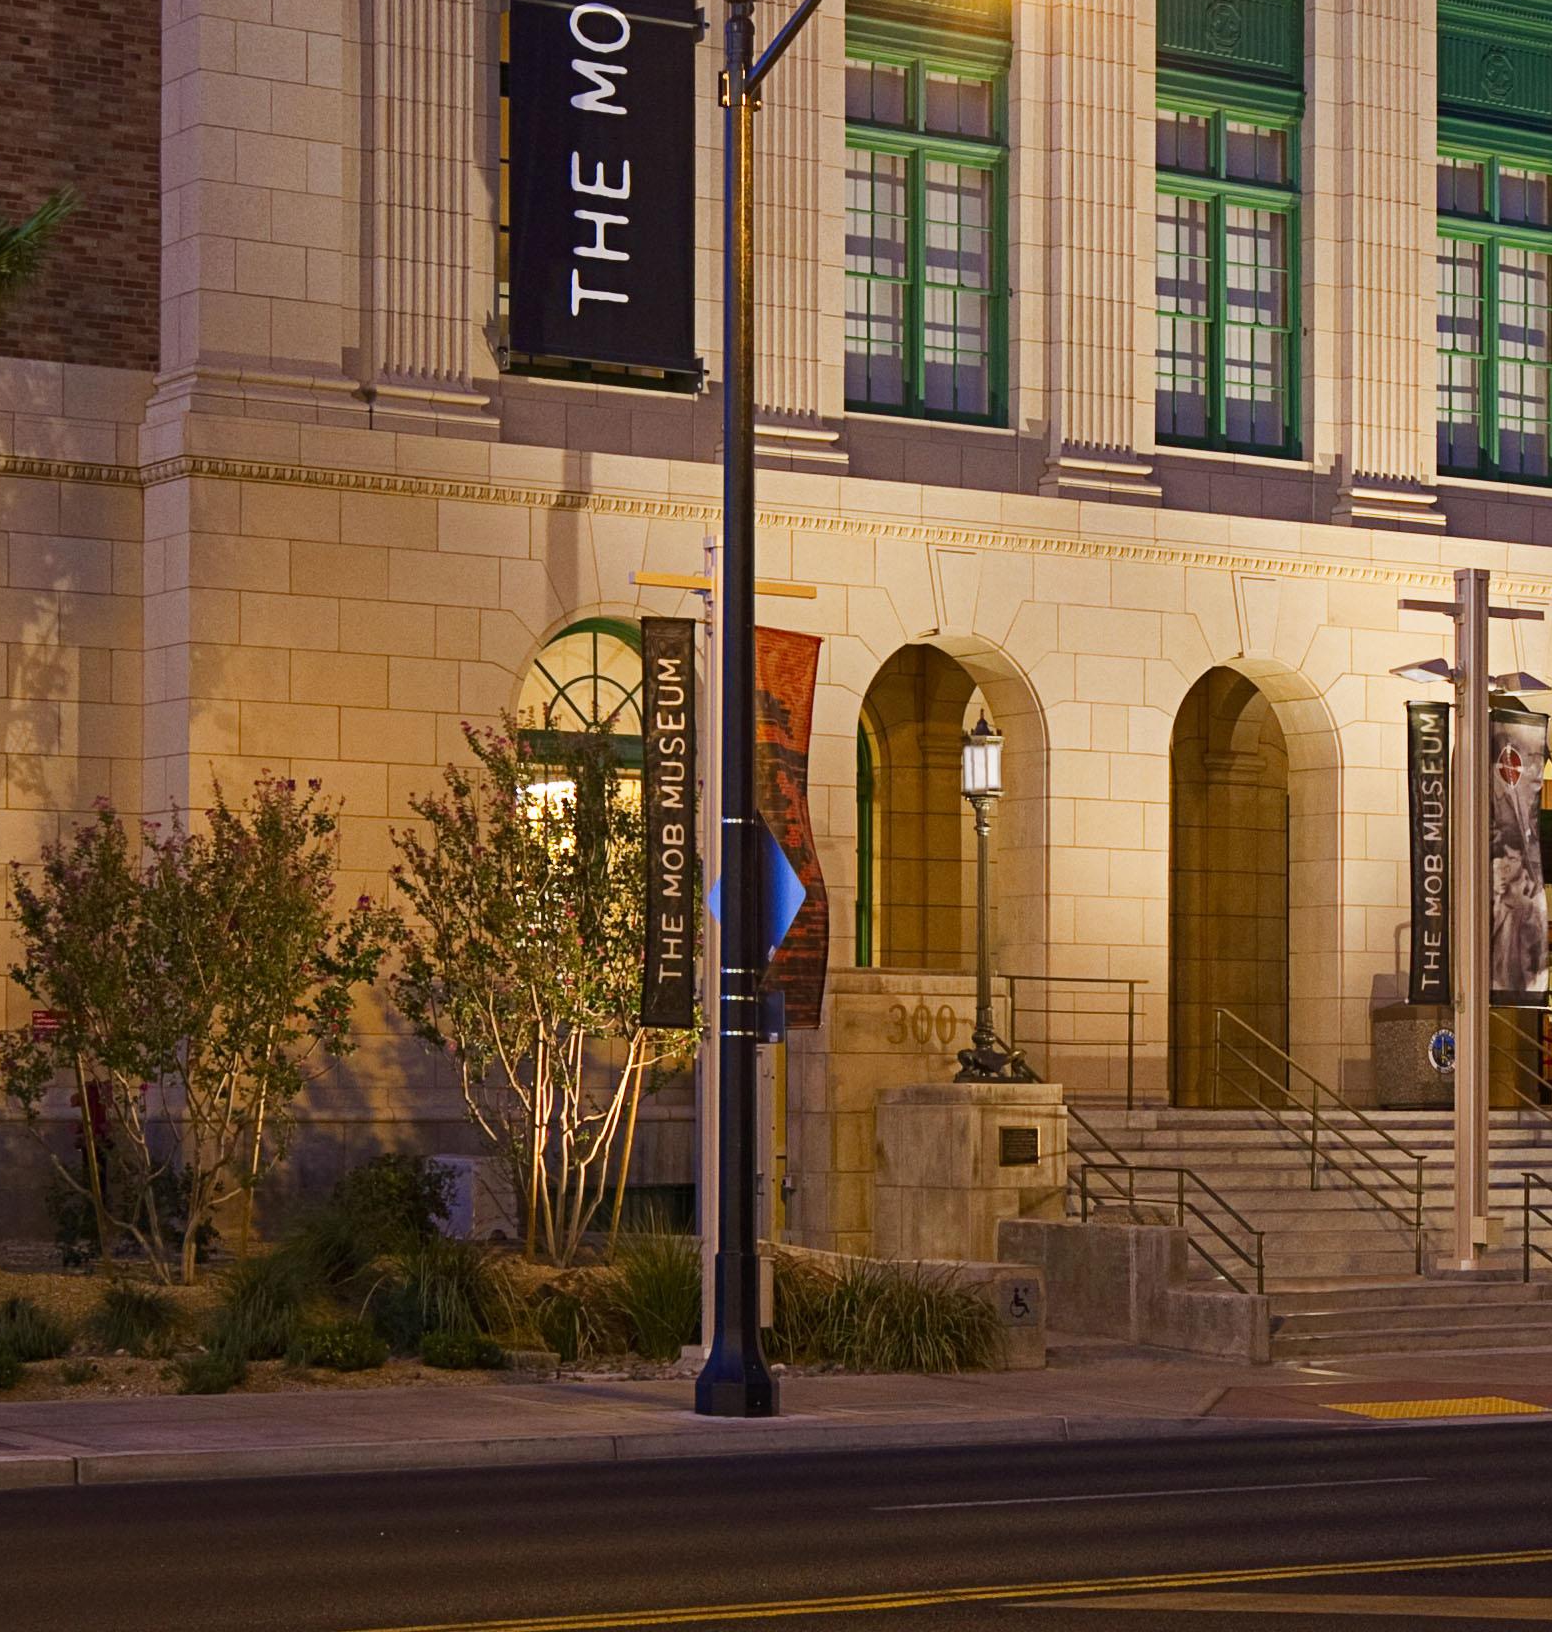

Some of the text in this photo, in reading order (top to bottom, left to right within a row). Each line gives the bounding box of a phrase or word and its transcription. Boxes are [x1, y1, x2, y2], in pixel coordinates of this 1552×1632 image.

[571, 151, 631, 317] THE
[656, 658, 686, 984] THE MOB MUSEUM
[1420, 712, 1444, 991] THE MOB MUSEUM
[887, 1003, 957, 1045] 300
